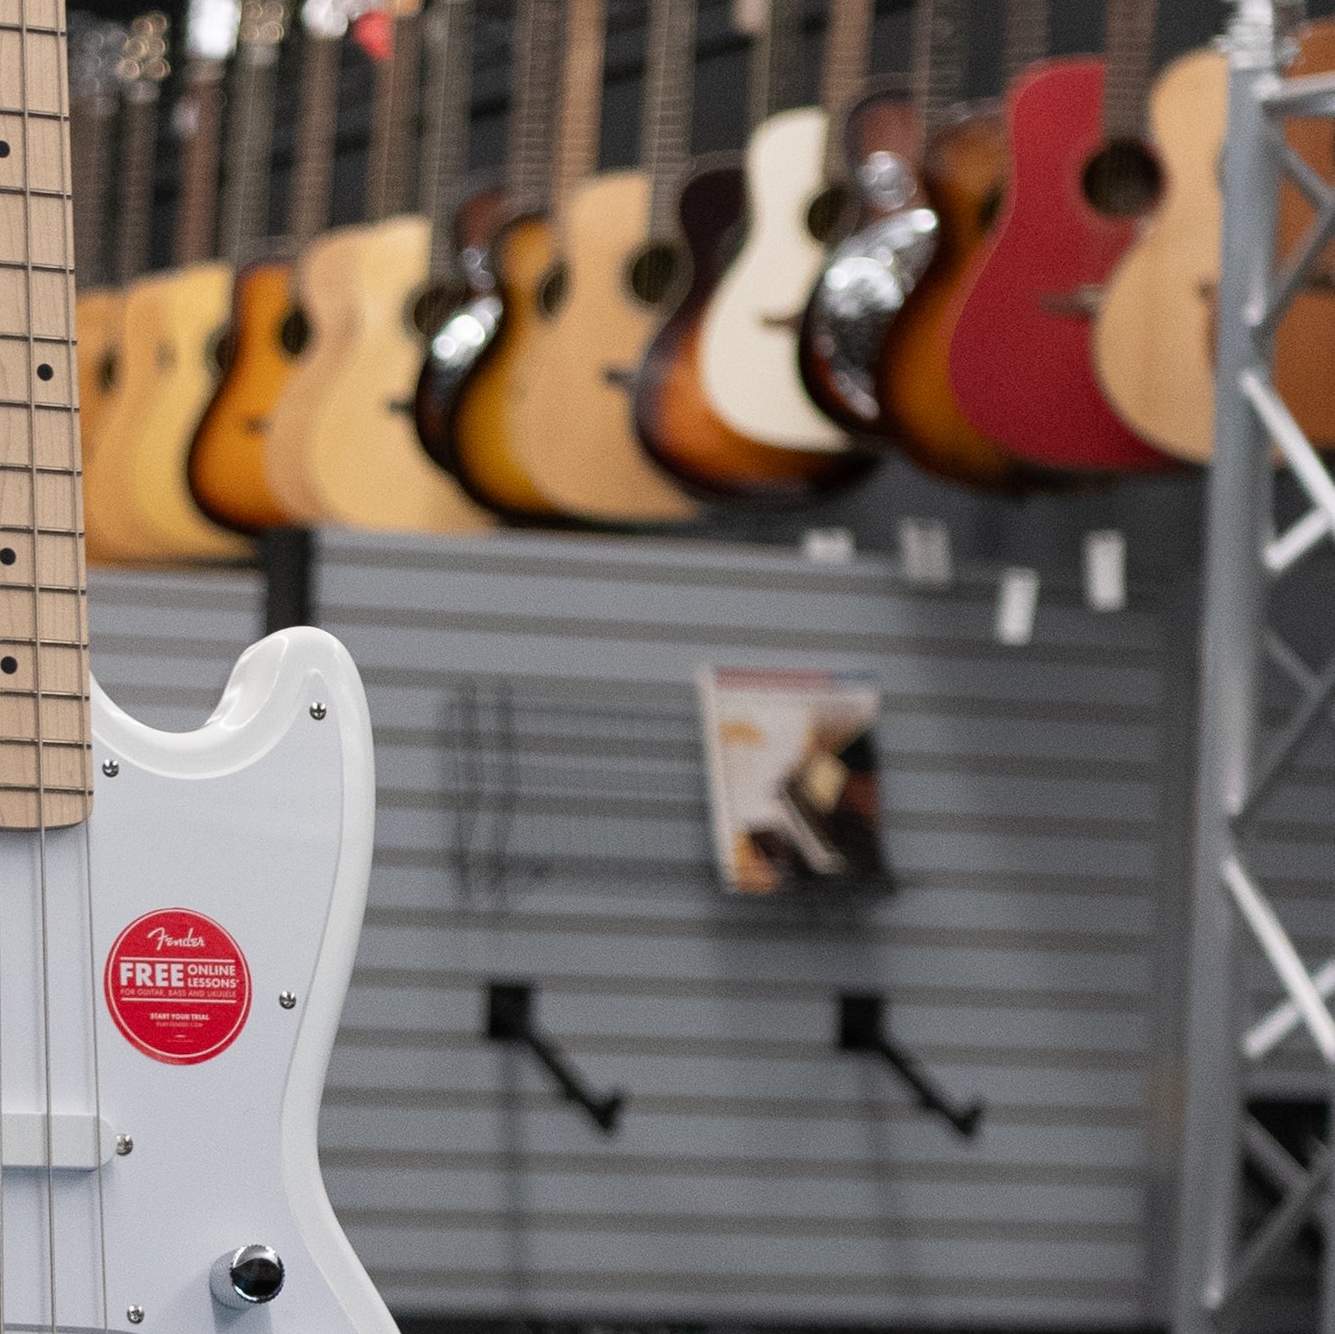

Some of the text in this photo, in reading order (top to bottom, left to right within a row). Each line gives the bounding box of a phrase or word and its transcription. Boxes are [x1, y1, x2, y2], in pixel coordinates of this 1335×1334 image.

[146, 926, 206, 951] Fender
[119, 962, 236, 987] FREE ONLINE
[120, 988, 136, 996] FOR
[168, 989, 186, 997] BASS
[187, 989, 205, 998] AND
[150, 1012, 210, 1021] START YOUR TRIAL
